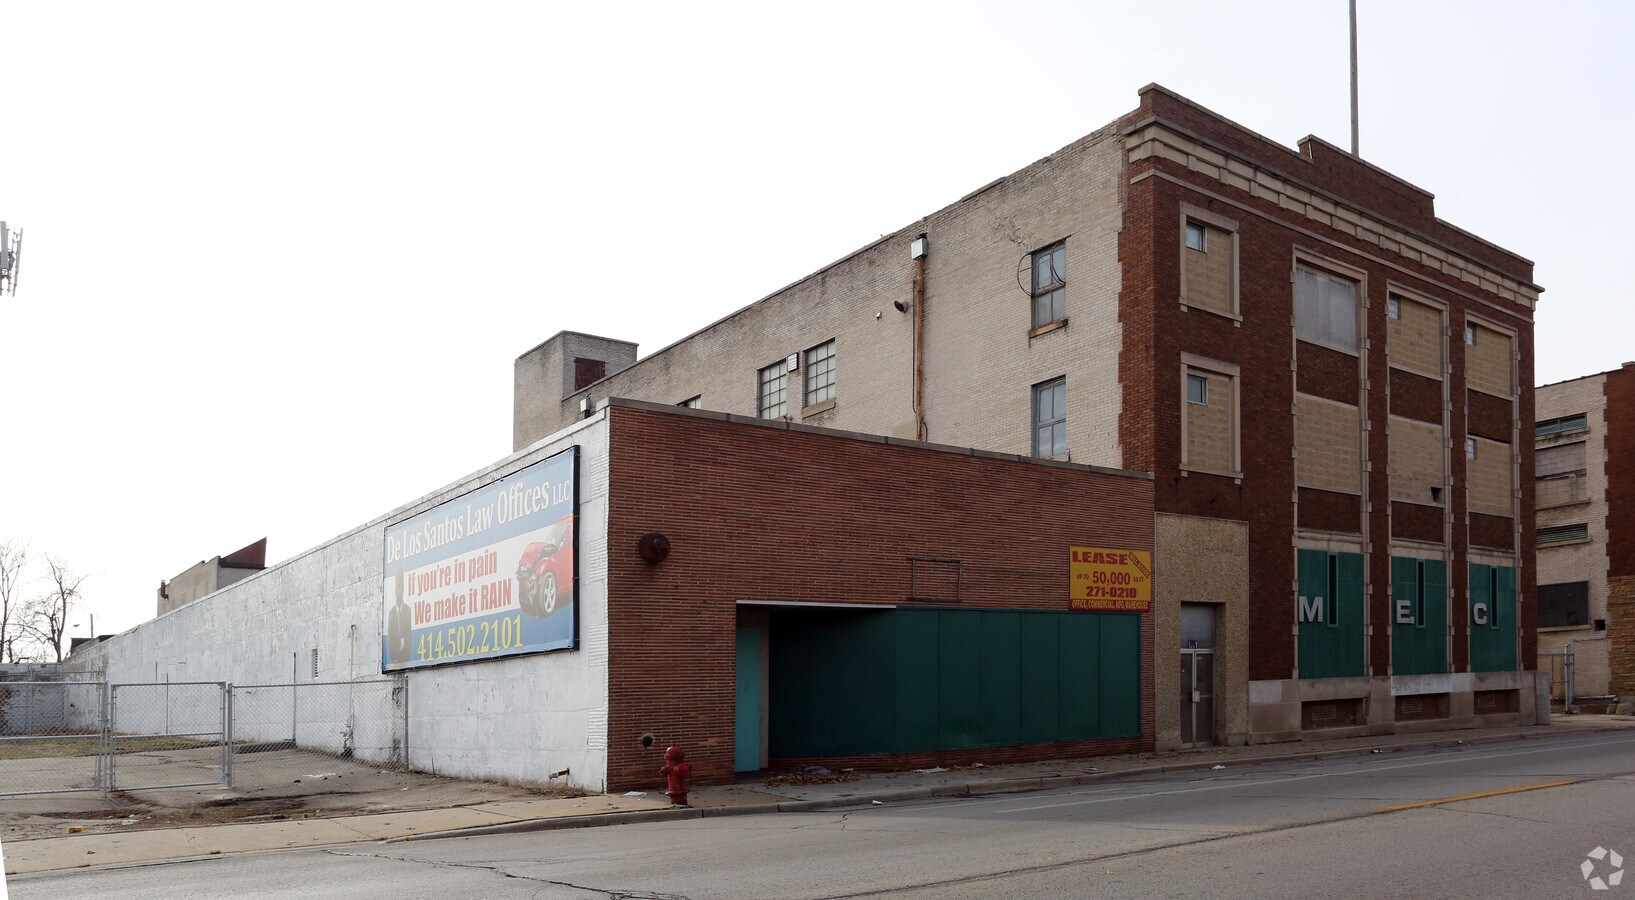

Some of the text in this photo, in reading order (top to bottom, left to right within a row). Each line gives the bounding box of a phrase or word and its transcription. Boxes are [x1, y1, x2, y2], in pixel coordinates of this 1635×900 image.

[387, 480, 570, 564] De Los Santos Law Offices LLC
[408, 549, 498, 597] If you're in pain
[1072, 551, 1128, 565] LEASE
[1086, 585, 1137, 598] 271-0210
[1092, 571, 1131, 586] 50,000
[414, 578, 512, 625] We make it RAIN
[1298, 596, 1323, 622] M
[1473, 602, 1488, 625] C
[417, 614, 523, 662] 414.502.2101
